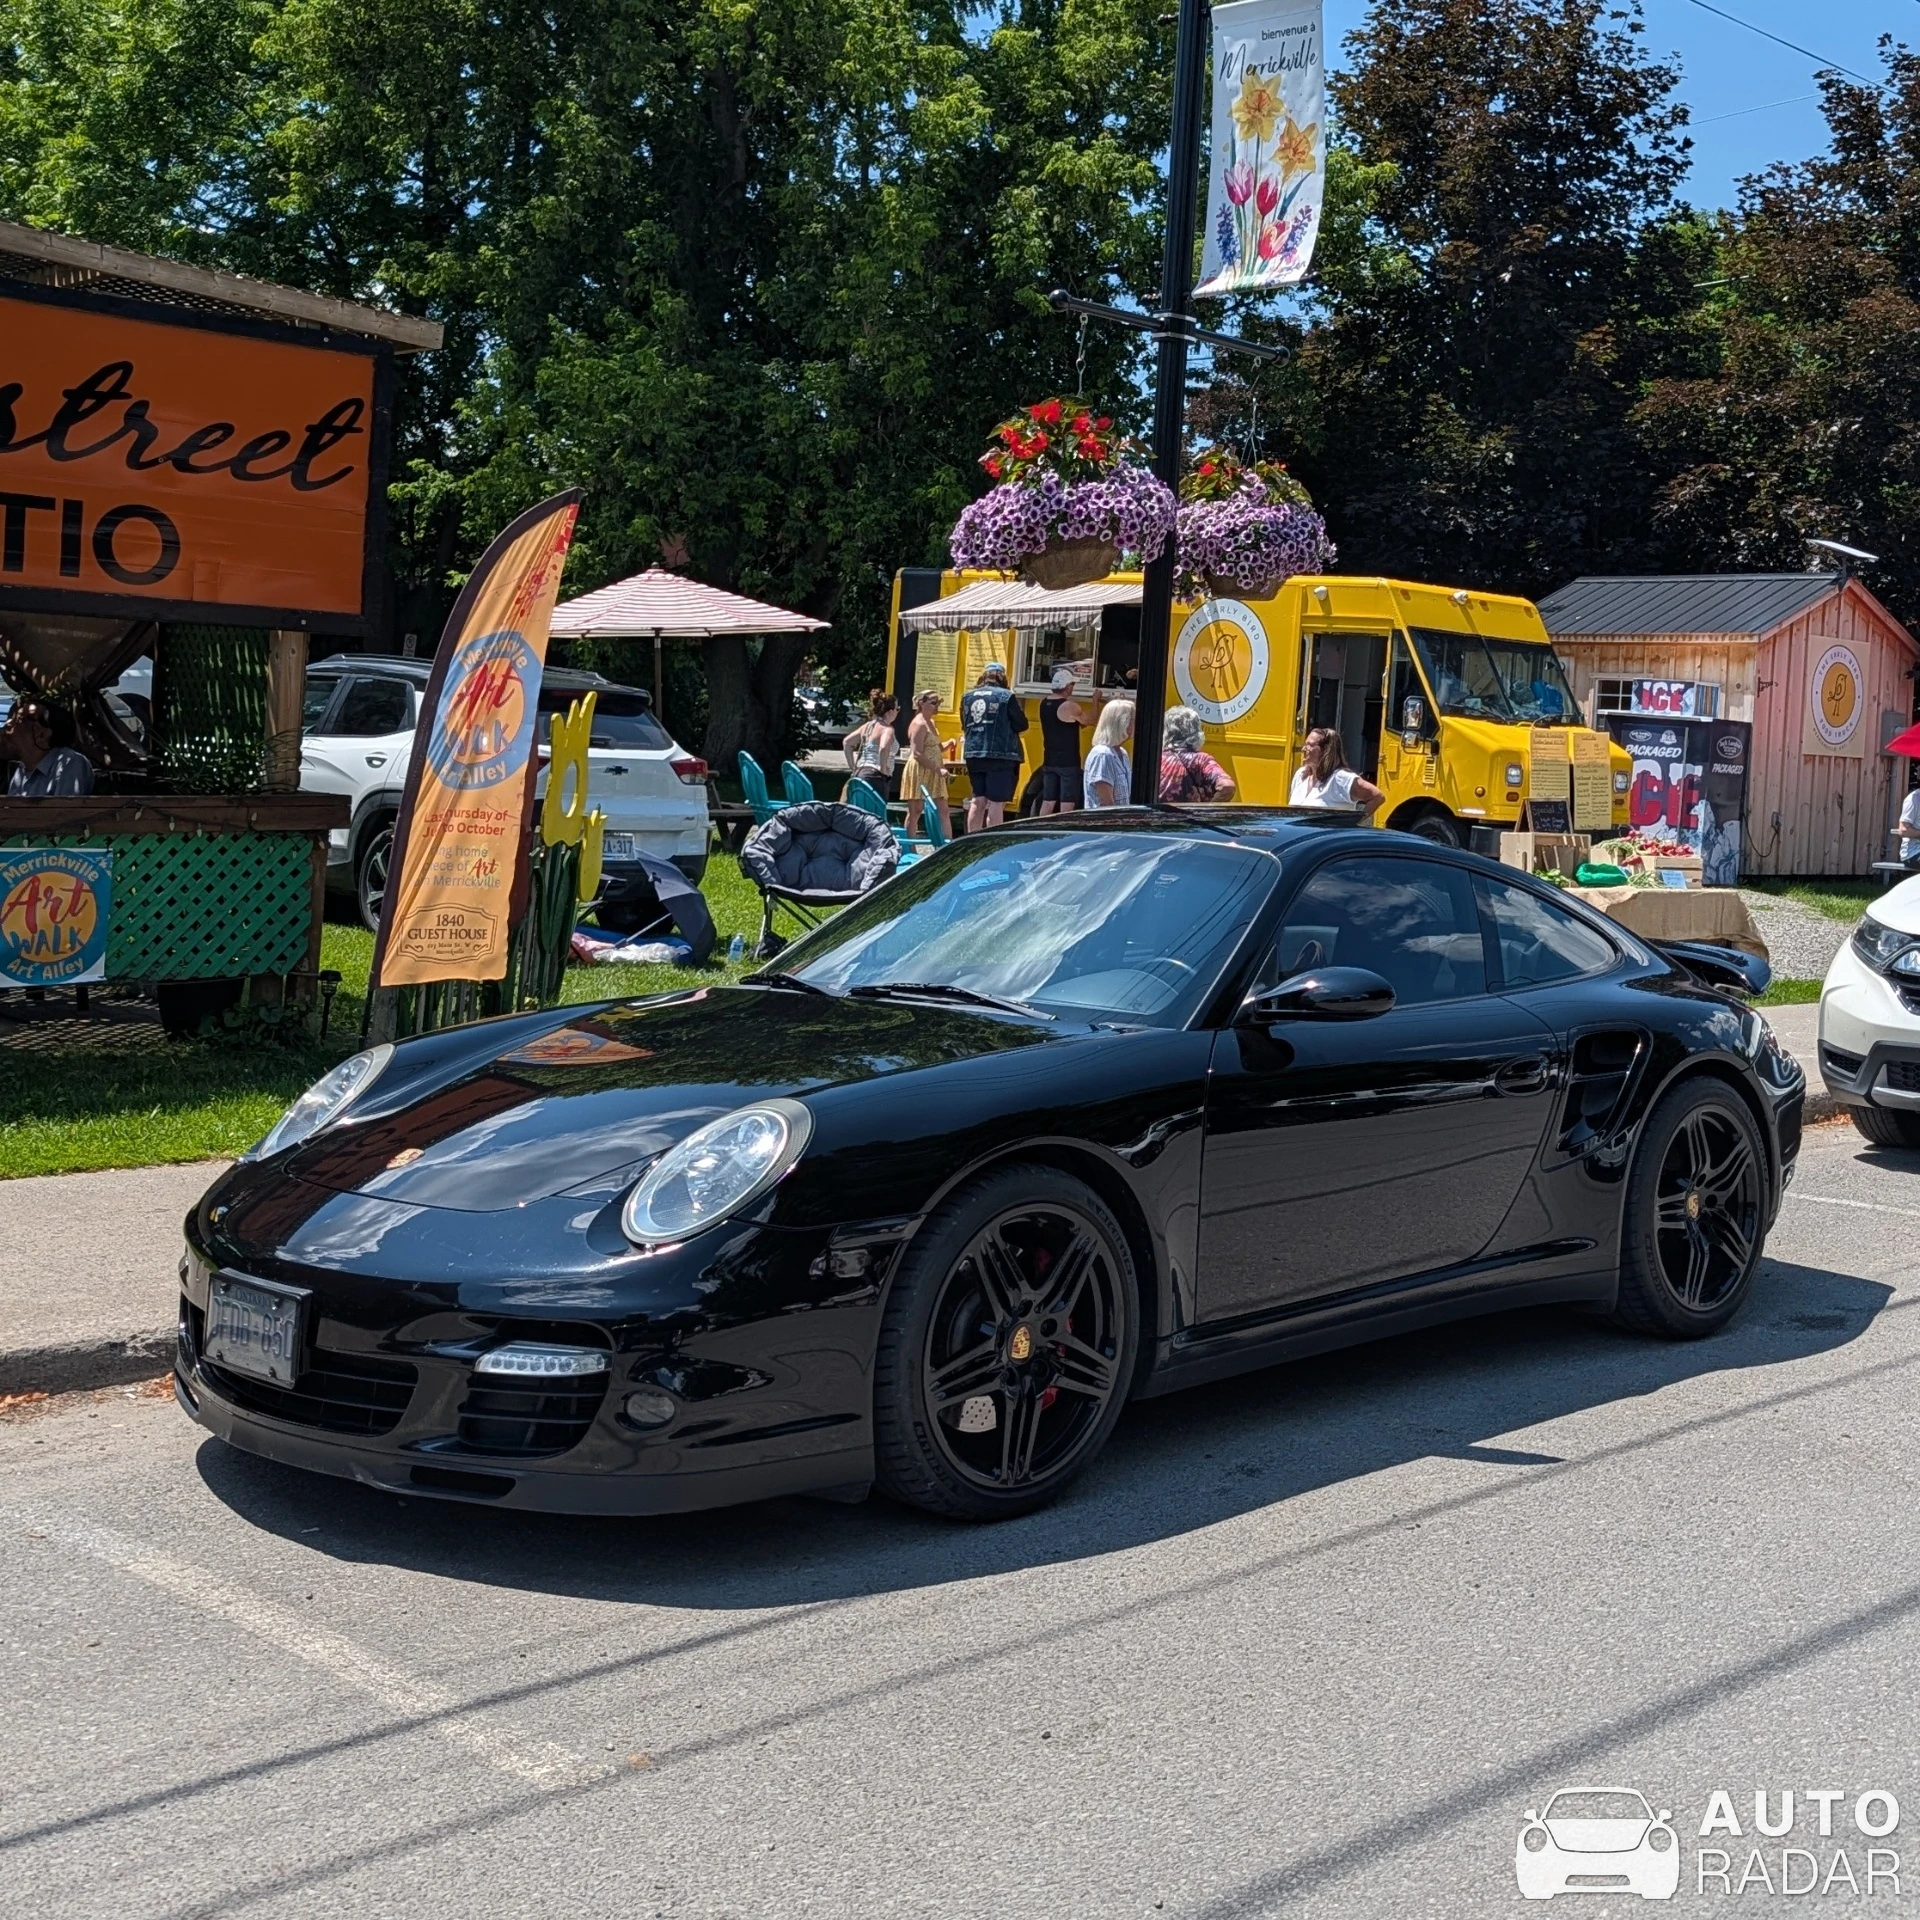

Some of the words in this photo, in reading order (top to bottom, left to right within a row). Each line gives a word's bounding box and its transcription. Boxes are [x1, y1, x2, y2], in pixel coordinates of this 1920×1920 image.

[1261, 24, 1308, 41] bienvenue
[1310, 21, 1316, 32] à
[1219, 37, 1318, 85] Merrickville
[1185, 616, 1202, 638] THE
[1206, 605, 1238, 617] EARLY
[1241, 613, 1260, 641] BIRD
[445, 662, 523, 730] Art
[1186, 691, 1211, 715] FOOD
[1217, 695, 1250, 717] TRUCK
[1640, 681, 1685, 712] ICE
[449, 719, 511, 758] WLK
[1625, 744, 1683, 759] PACKAGED
[441, 764, 460, 781] Ar
[461, 761, 506, 785] Alley
[1711, 763, 1744, 775] PACKAGED
[1629, 759, 1704, 830] CE
[424, 811, 444, 823] Las
[444, 808, 493, 822] hursday
[495, 810, 508, 822] of
[457, 822, 506, 836] October
[455, 844, 488, 858] home
[2, 852, 99, 884] Merrickville
[457, 859, 469, 872] of
[468, 858, 499, 879] Art
[433, 875, 501, 888] Merrickville
[0, 874, 92, 934] Art
[435, 913, 465, 927] 1840
[9, 923, 85, 956] WALK
[407, 927, 447, 940] GUEST
[448, 927, 488, 940] HOUSE
[6, 957, 39, 979] Art
[42, 957, 84, 980] Alley
[236, 1287, 271, 1307] ONTARIO
